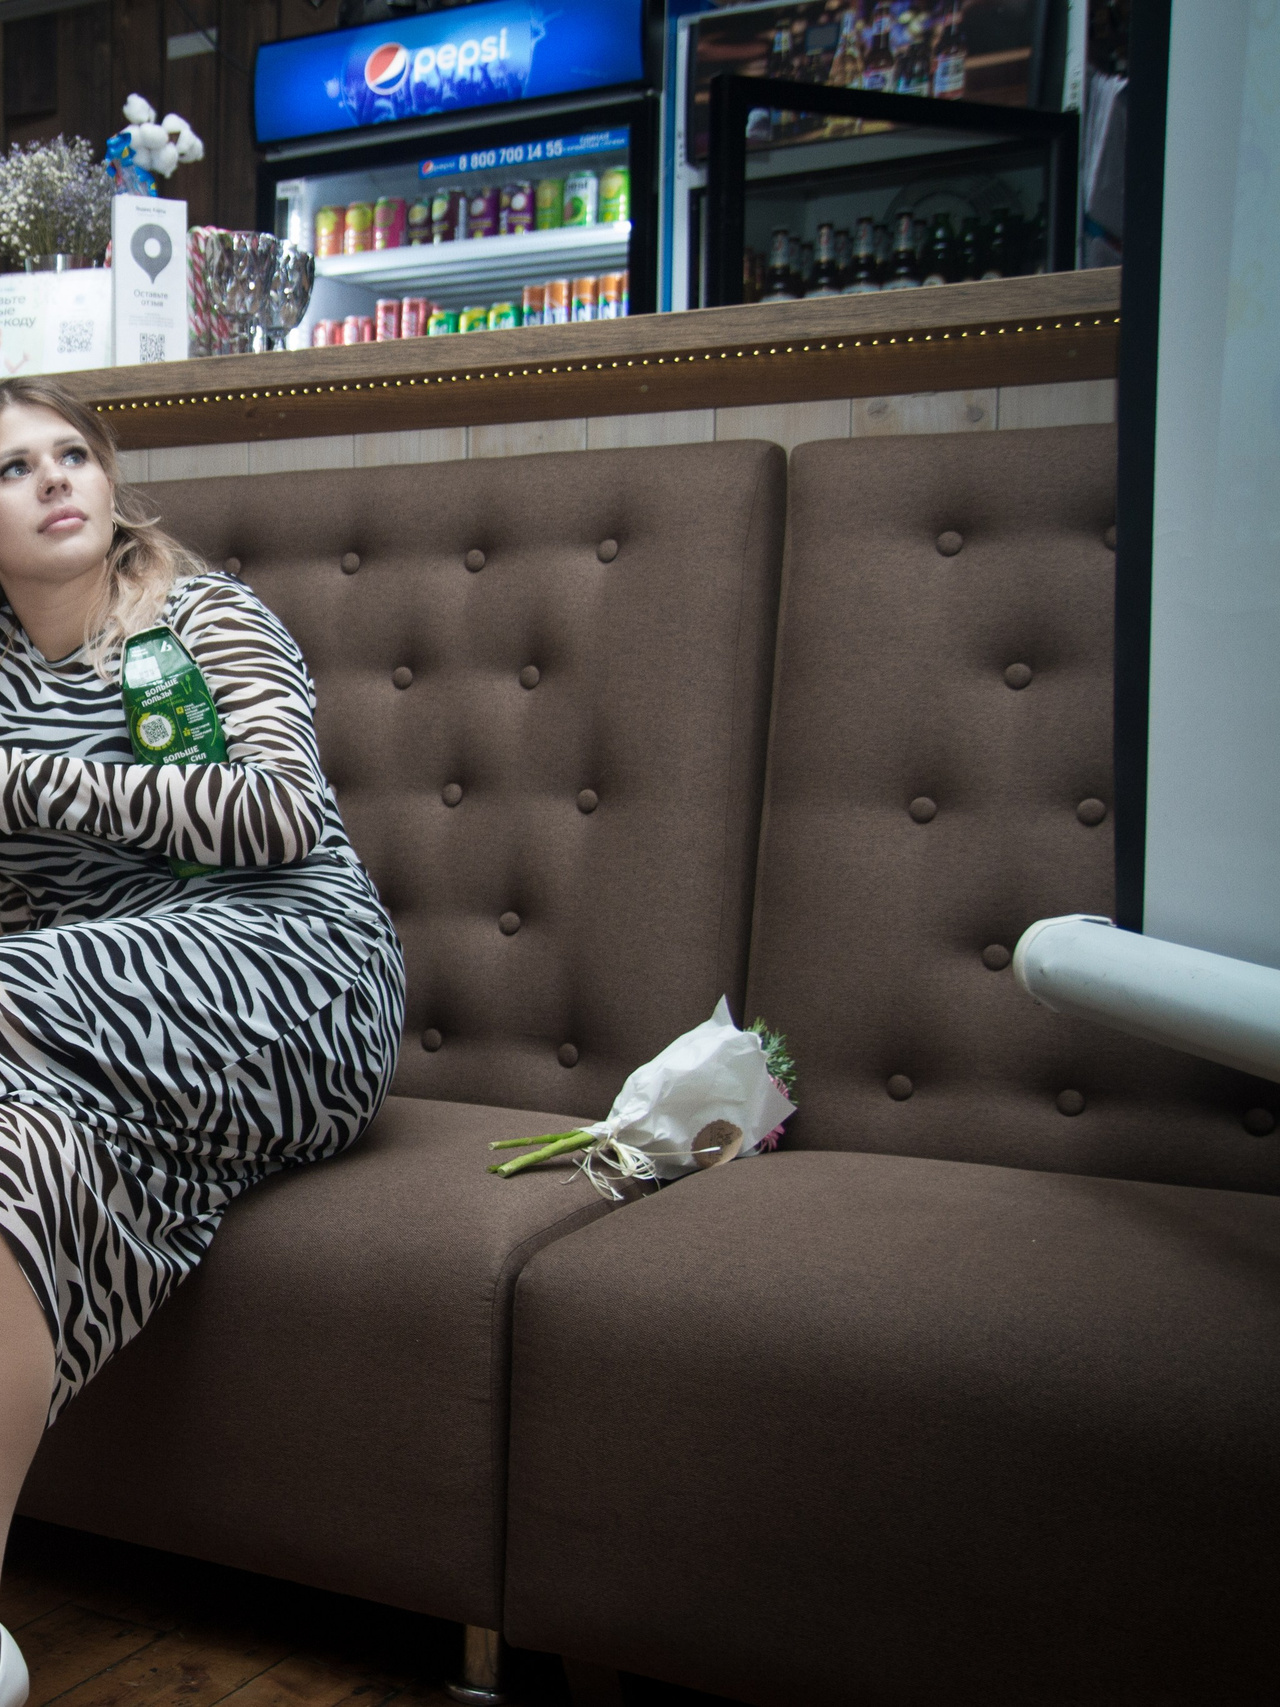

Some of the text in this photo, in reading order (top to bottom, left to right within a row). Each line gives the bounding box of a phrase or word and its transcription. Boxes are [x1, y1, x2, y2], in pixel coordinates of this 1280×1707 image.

[413, 27, 508, 83] pepsi
[458, 155, 467, 172] 8
[470, 149, 496, 171] 800
[499, 147, 524, 167] 700
[526, 143, 542, 161] 14
[546, 139, 564, 157] 55
[133, 288, 169, 300] Оставьте
[140, 299, 164, 308] отзыв
[144, 678, 179, 698] БОЛЬШЕ
[141, 689, 173, 708] ПОЛЬЗЫ
[162, 745, 200, 764] БОЛЬШЕ
[190, 752, 207, 763] СИЛ
